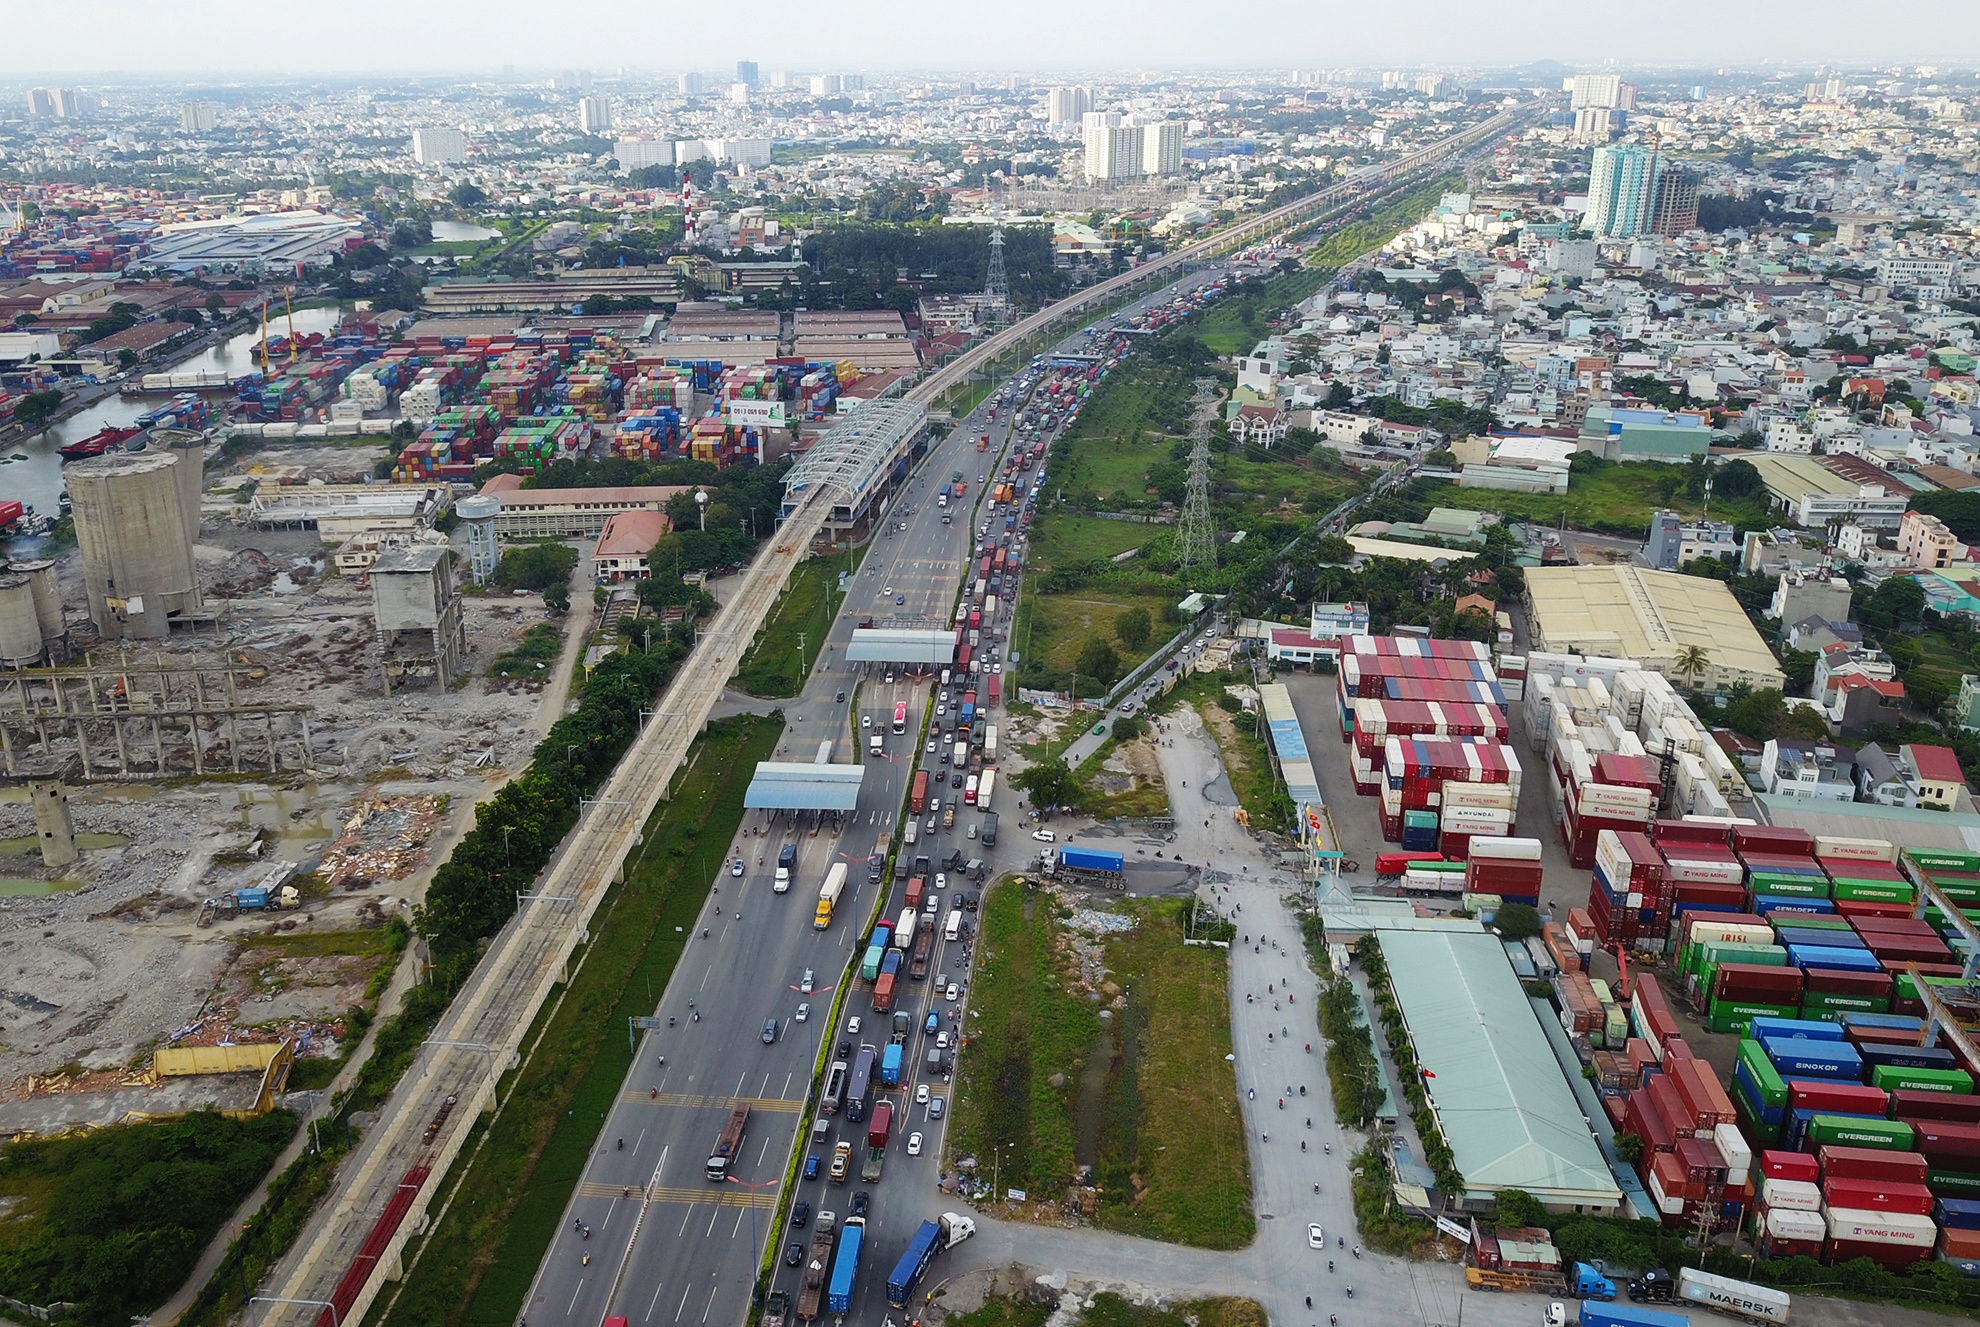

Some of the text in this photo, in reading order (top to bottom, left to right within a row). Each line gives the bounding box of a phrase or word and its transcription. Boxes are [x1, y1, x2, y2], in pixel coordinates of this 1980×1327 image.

[1770, 884, 1814, 892] EVERGREEN
[1852, 889, 1897, 898] EVERGREEN
[1721, 934, 1748, 942] IRISL
[1824, 998, 1872, 1006] EVERGREEN
[1733, 1007, 1780, 1016] EVERGREEN
[1796, 1062, 1838, 1072] SINOKOR
[1900, 1081, 1953, 1091] EVERGREEN
[1838, 1132, 1893, 1143] EVERGREEN
[1864, 1228, 1915, 1239] YANG MING
[1709, 1292, 1774, 1316] MAERSK
